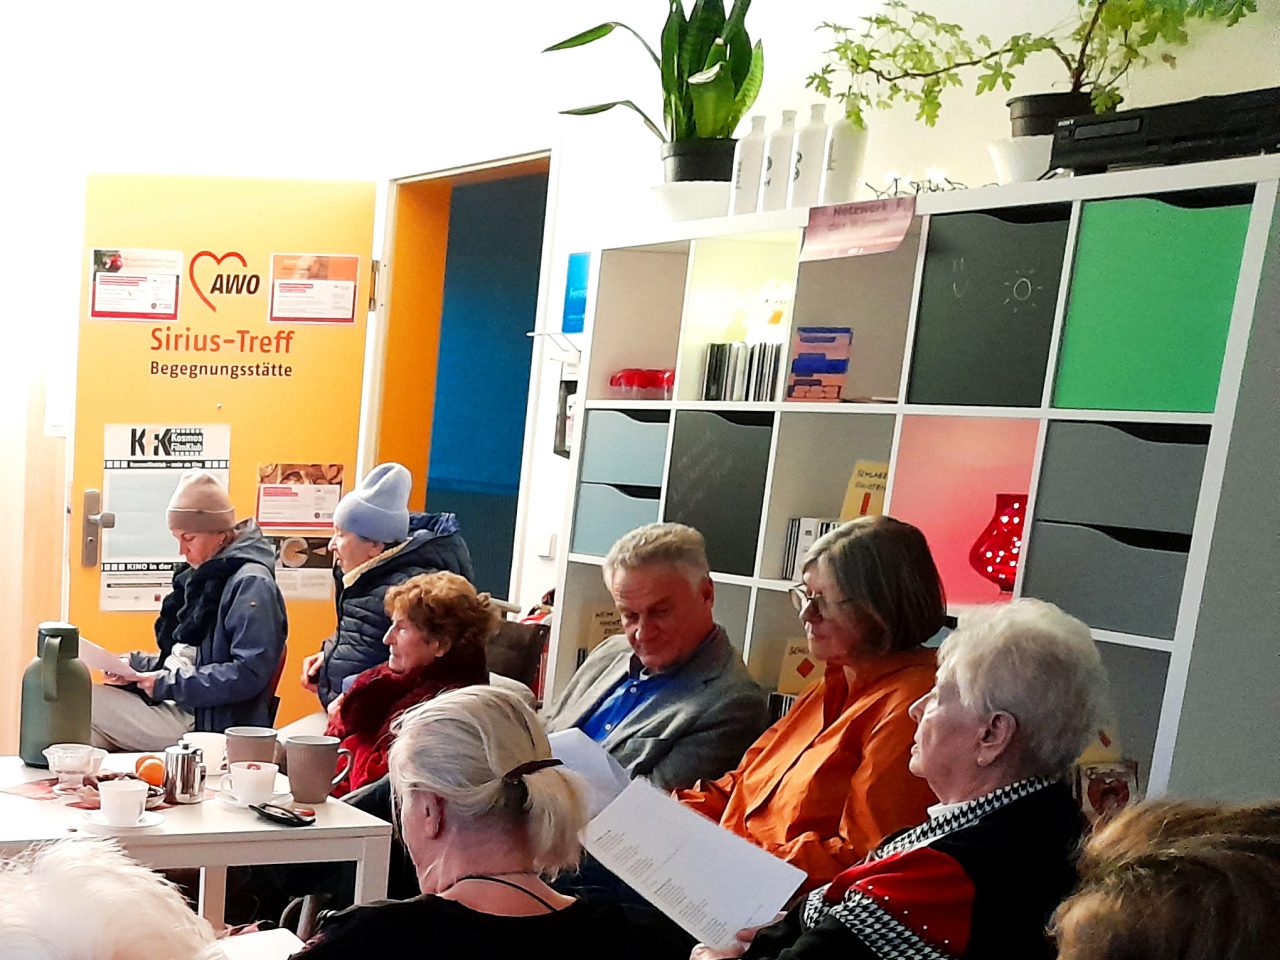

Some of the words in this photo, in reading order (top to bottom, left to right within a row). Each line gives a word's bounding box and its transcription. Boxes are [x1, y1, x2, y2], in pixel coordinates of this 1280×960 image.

[209, 273, 261, 296] AWO
[150, 325, 296, 354] Sirius-Treff
[150, 360, 293, 380] Begegnungsstätte
[126, 562, 148, 571] KINO
[149, 562, 158, 571] in
[158, 562, 173, 571] der
